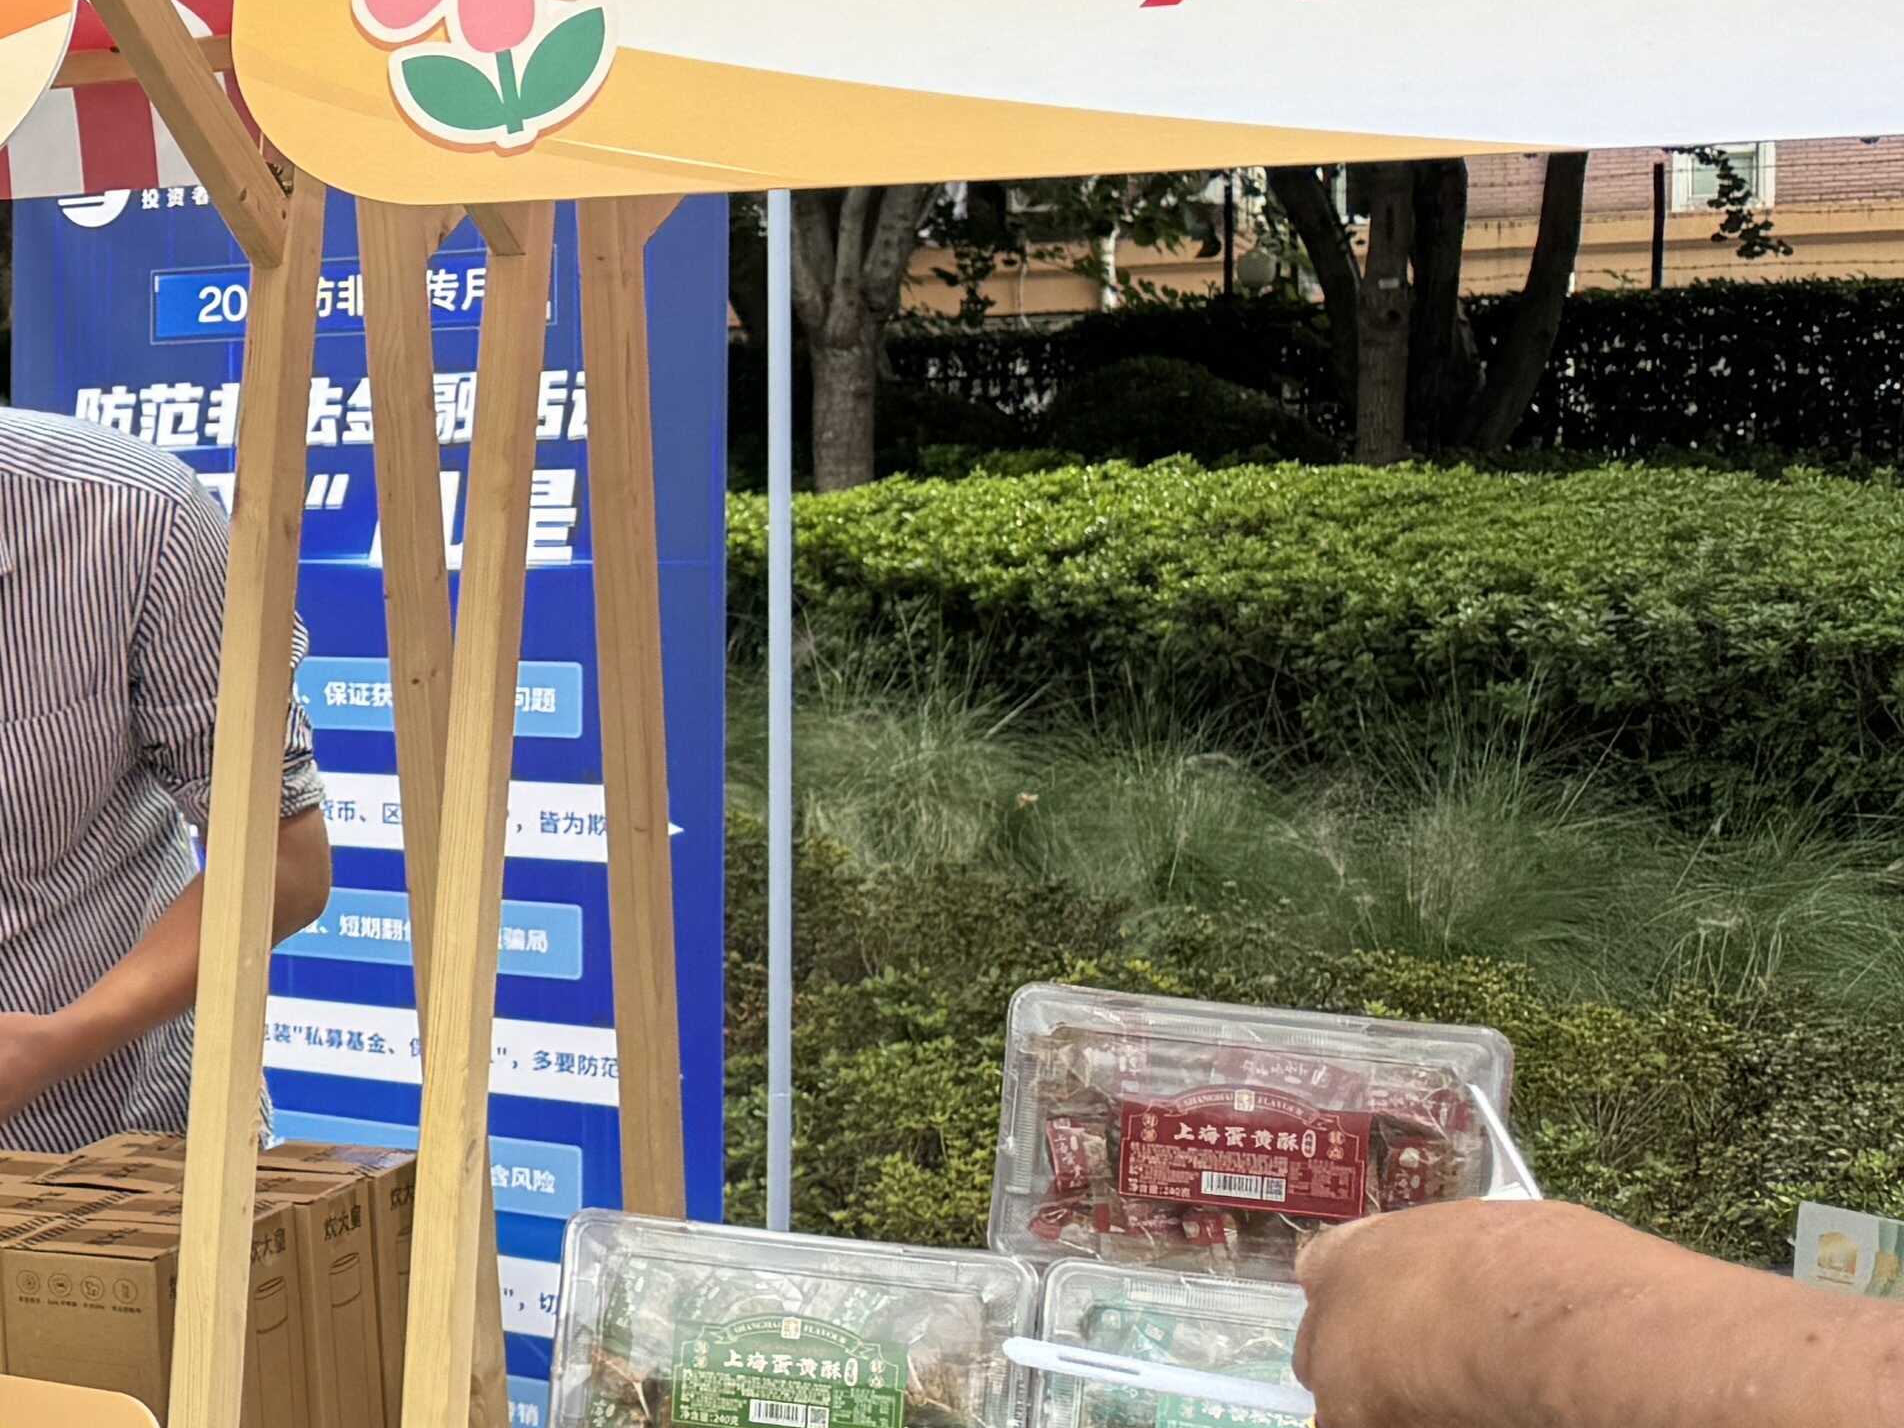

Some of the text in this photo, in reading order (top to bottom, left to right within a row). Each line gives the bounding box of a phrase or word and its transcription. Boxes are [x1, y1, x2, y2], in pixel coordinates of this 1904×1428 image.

[498, 928, 549, 953] 骗局
[1173, 1121, 1300, 1152] 上海蛋黄酥
[723, 1348, 843, 1381] 上海蛋黄酥
